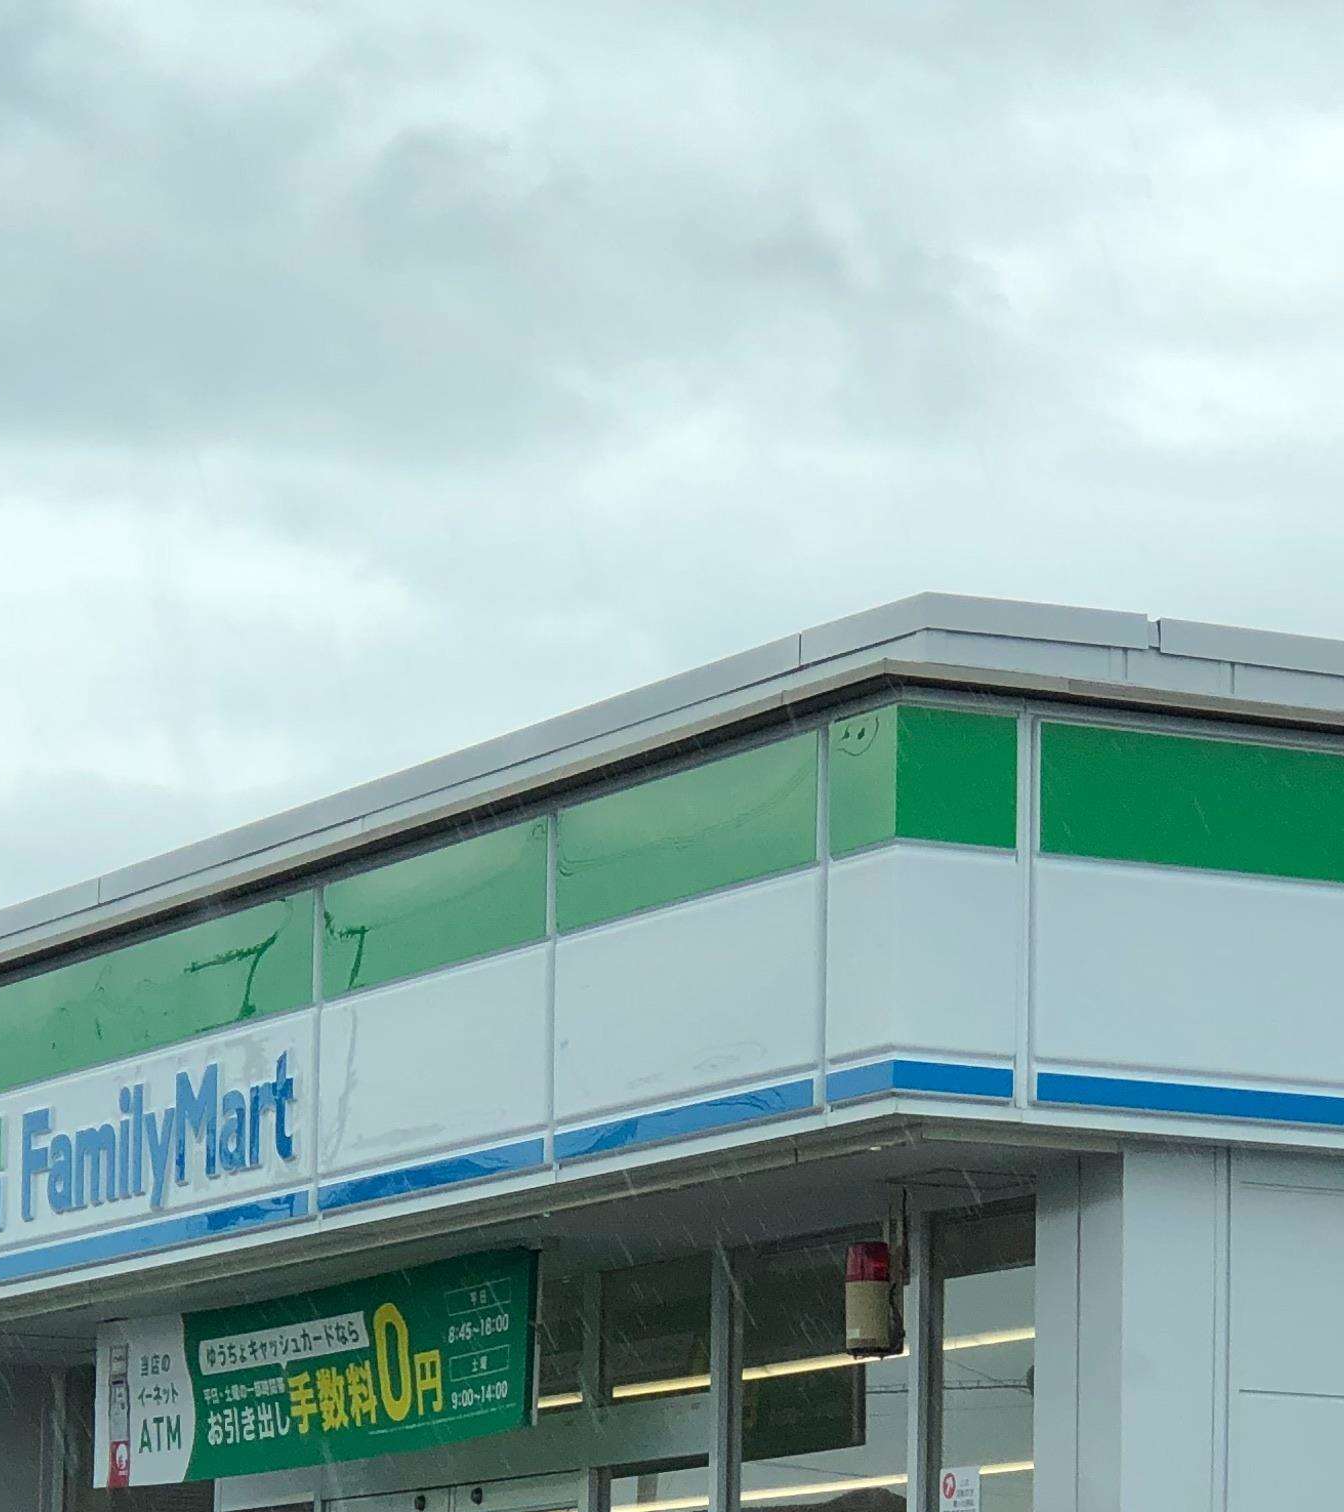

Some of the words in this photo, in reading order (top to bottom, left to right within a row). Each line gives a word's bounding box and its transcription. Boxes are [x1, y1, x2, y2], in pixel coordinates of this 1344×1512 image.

[20, 1050, 296, 1222] FamilyMart
[140, 1353, 171, 1377] 当店の
[206, 1321, 360, 1368] ゆうちょキャッシュカードなら
[137, 1382, 179, 1407] イーネット
[138, 1414, 182, 1454] ATM
[207, 1401, 291, 1446] お引き出し
